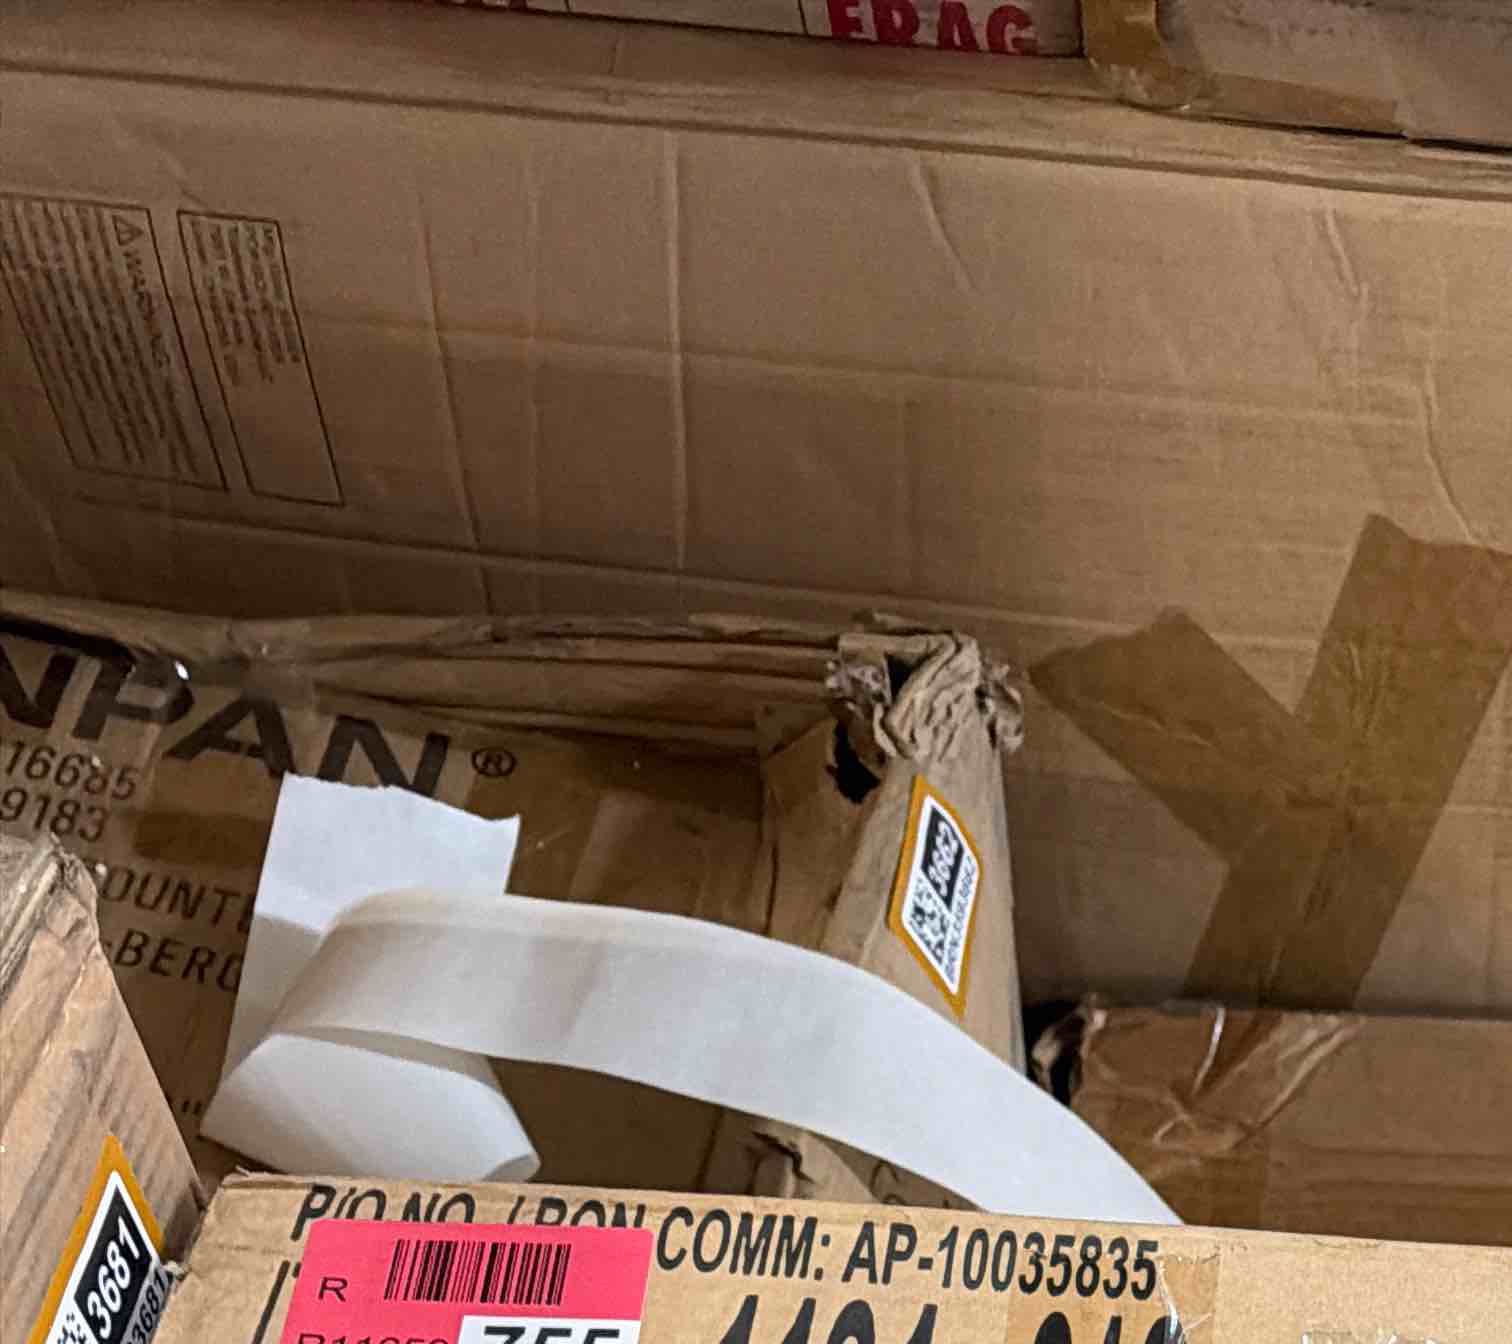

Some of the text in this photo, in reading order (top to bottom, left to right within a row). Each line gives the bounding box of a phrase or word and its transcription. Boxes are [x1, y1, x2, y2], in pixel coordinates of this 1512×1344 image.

[99, 865, 254, 935] OUNT
[88, 1216, 140, 1340] 3681
[318, 1276, 349, 1302] R
[656, 1206, 831, 1281] COMM:
[842, 1222, 1160, 1300] AP-10035835
